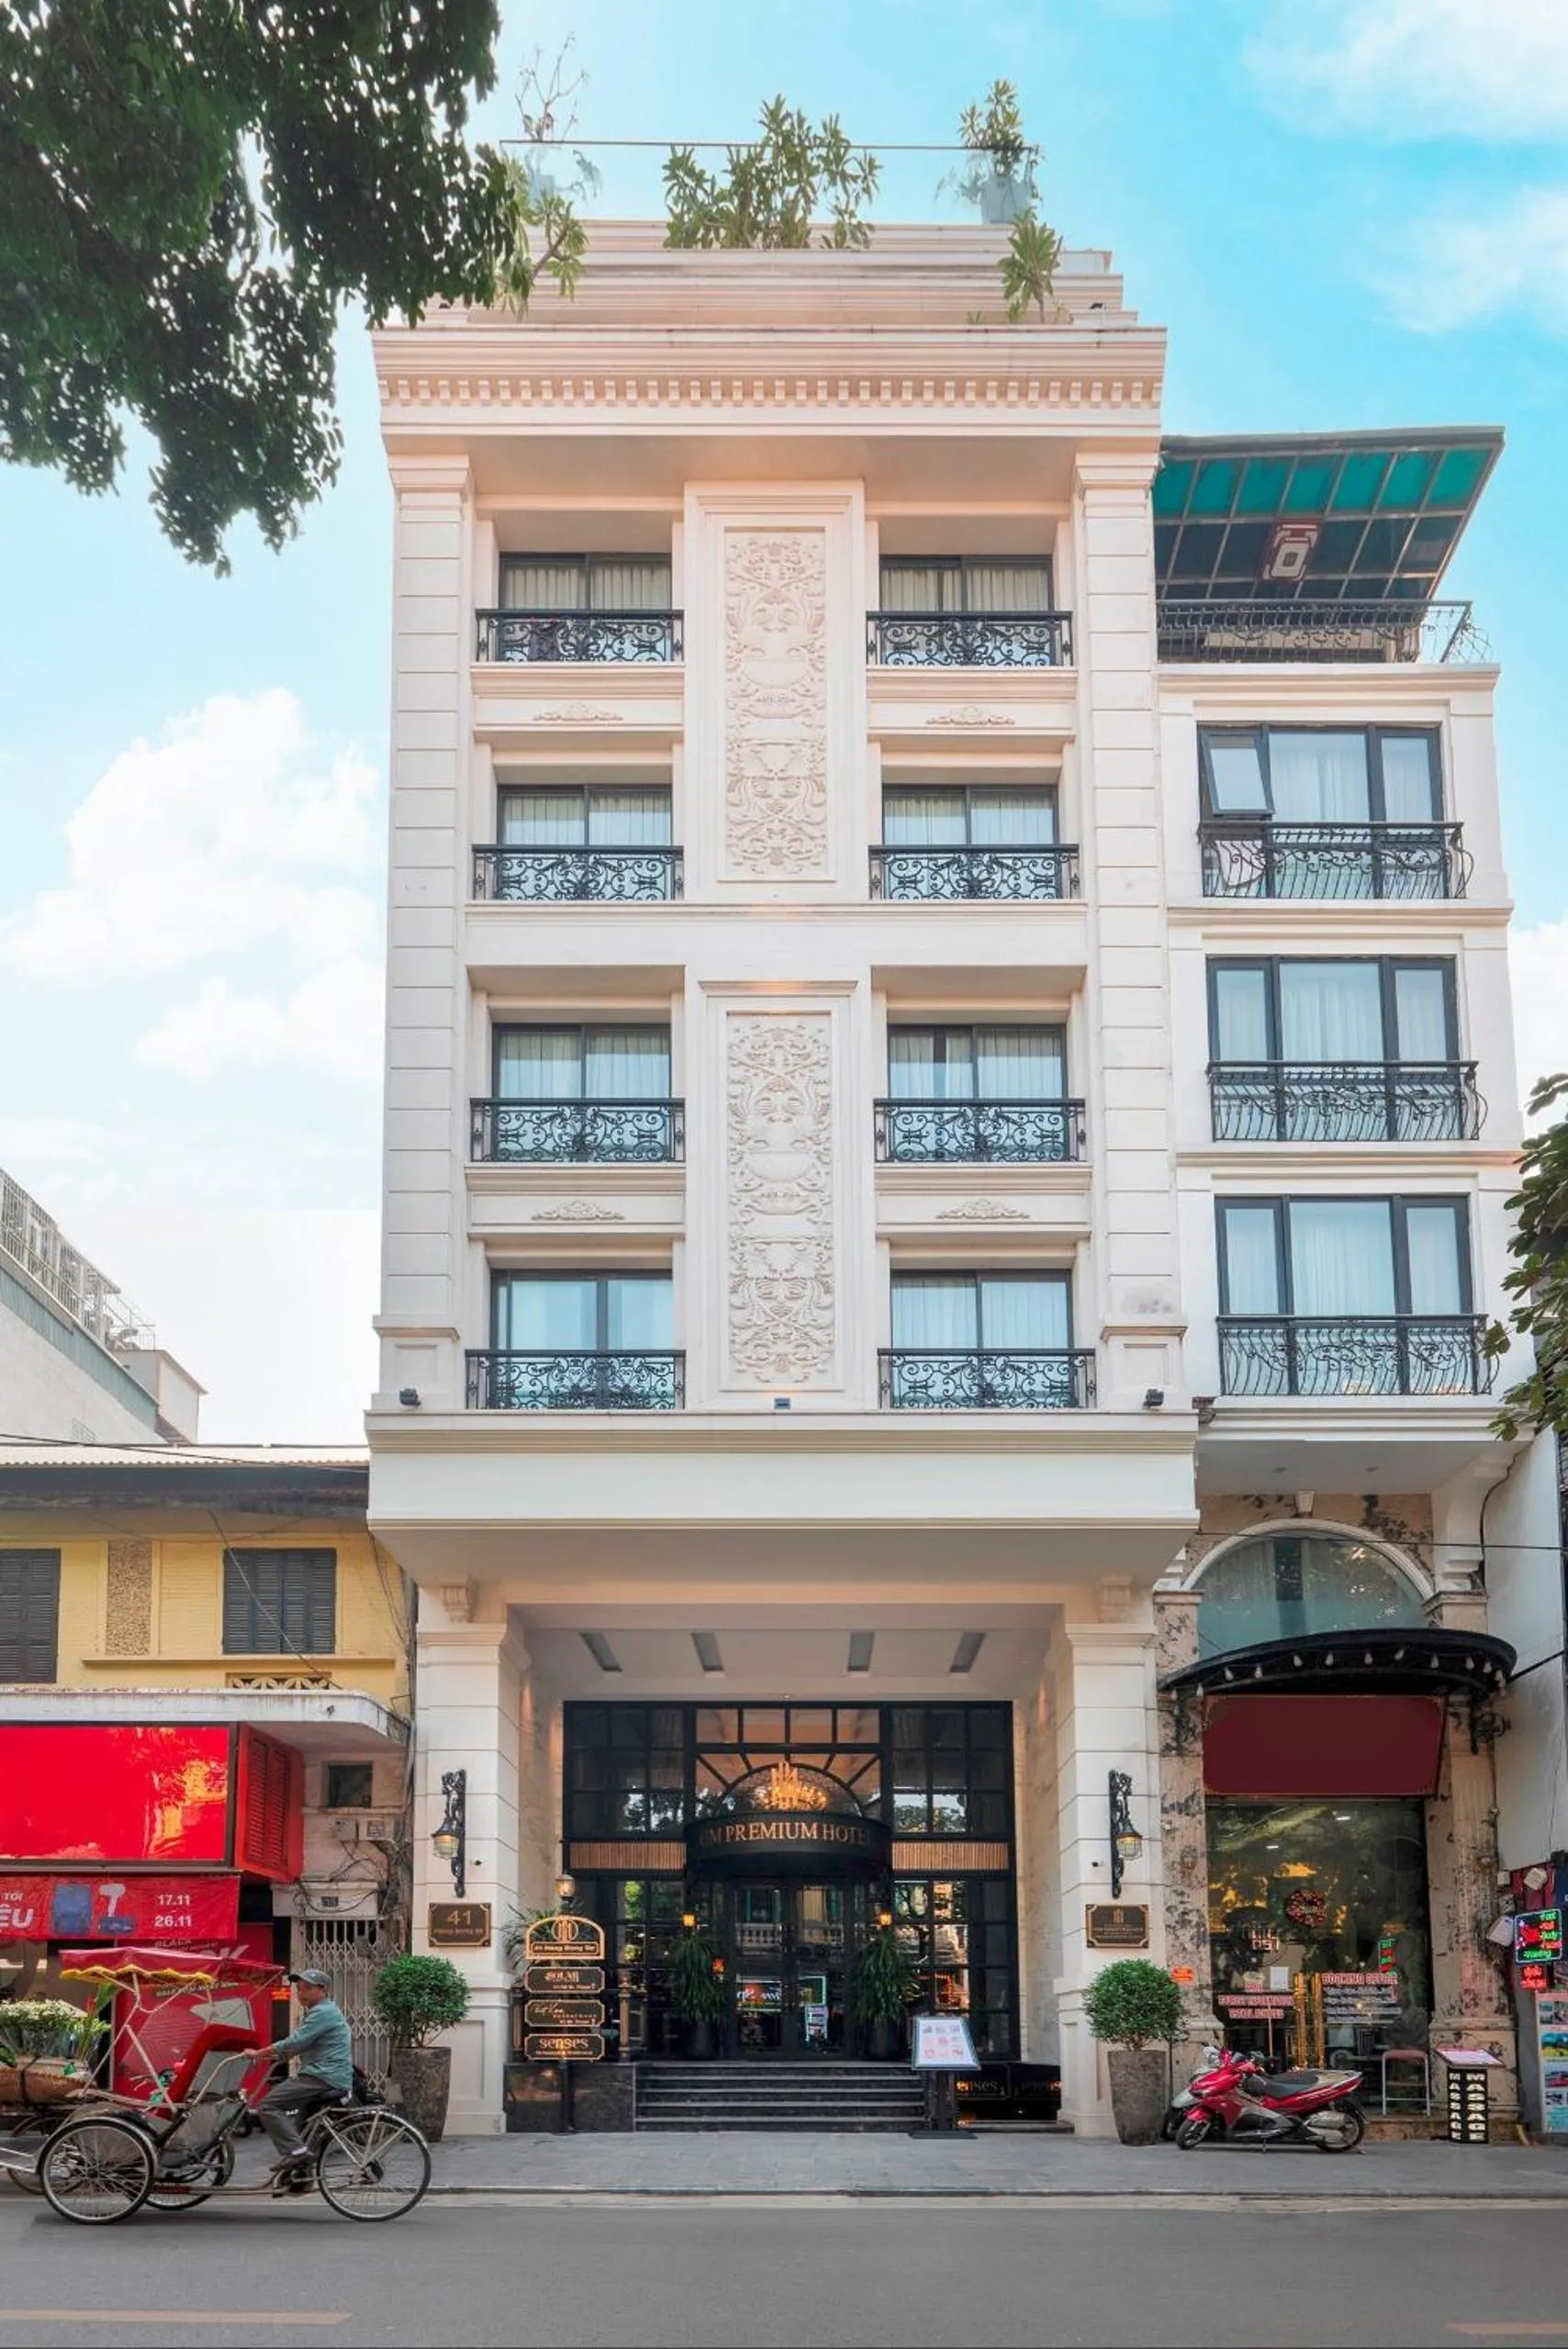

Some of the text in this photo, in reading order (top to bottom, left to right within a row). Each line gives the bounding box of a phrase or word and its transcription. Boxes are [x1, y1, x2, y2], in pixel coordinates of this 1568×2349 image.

[725, 1821, 818, 1843] PREMIUM
[157, 1894, 191, 1906] 17.11
[154, 1915, 193, 1928] 26.11
[446, 1909, 471, 1925] 41
[539, 2038, 588, 2050] senses
[1466, 2073, 1486, 2141] MASSAGE
